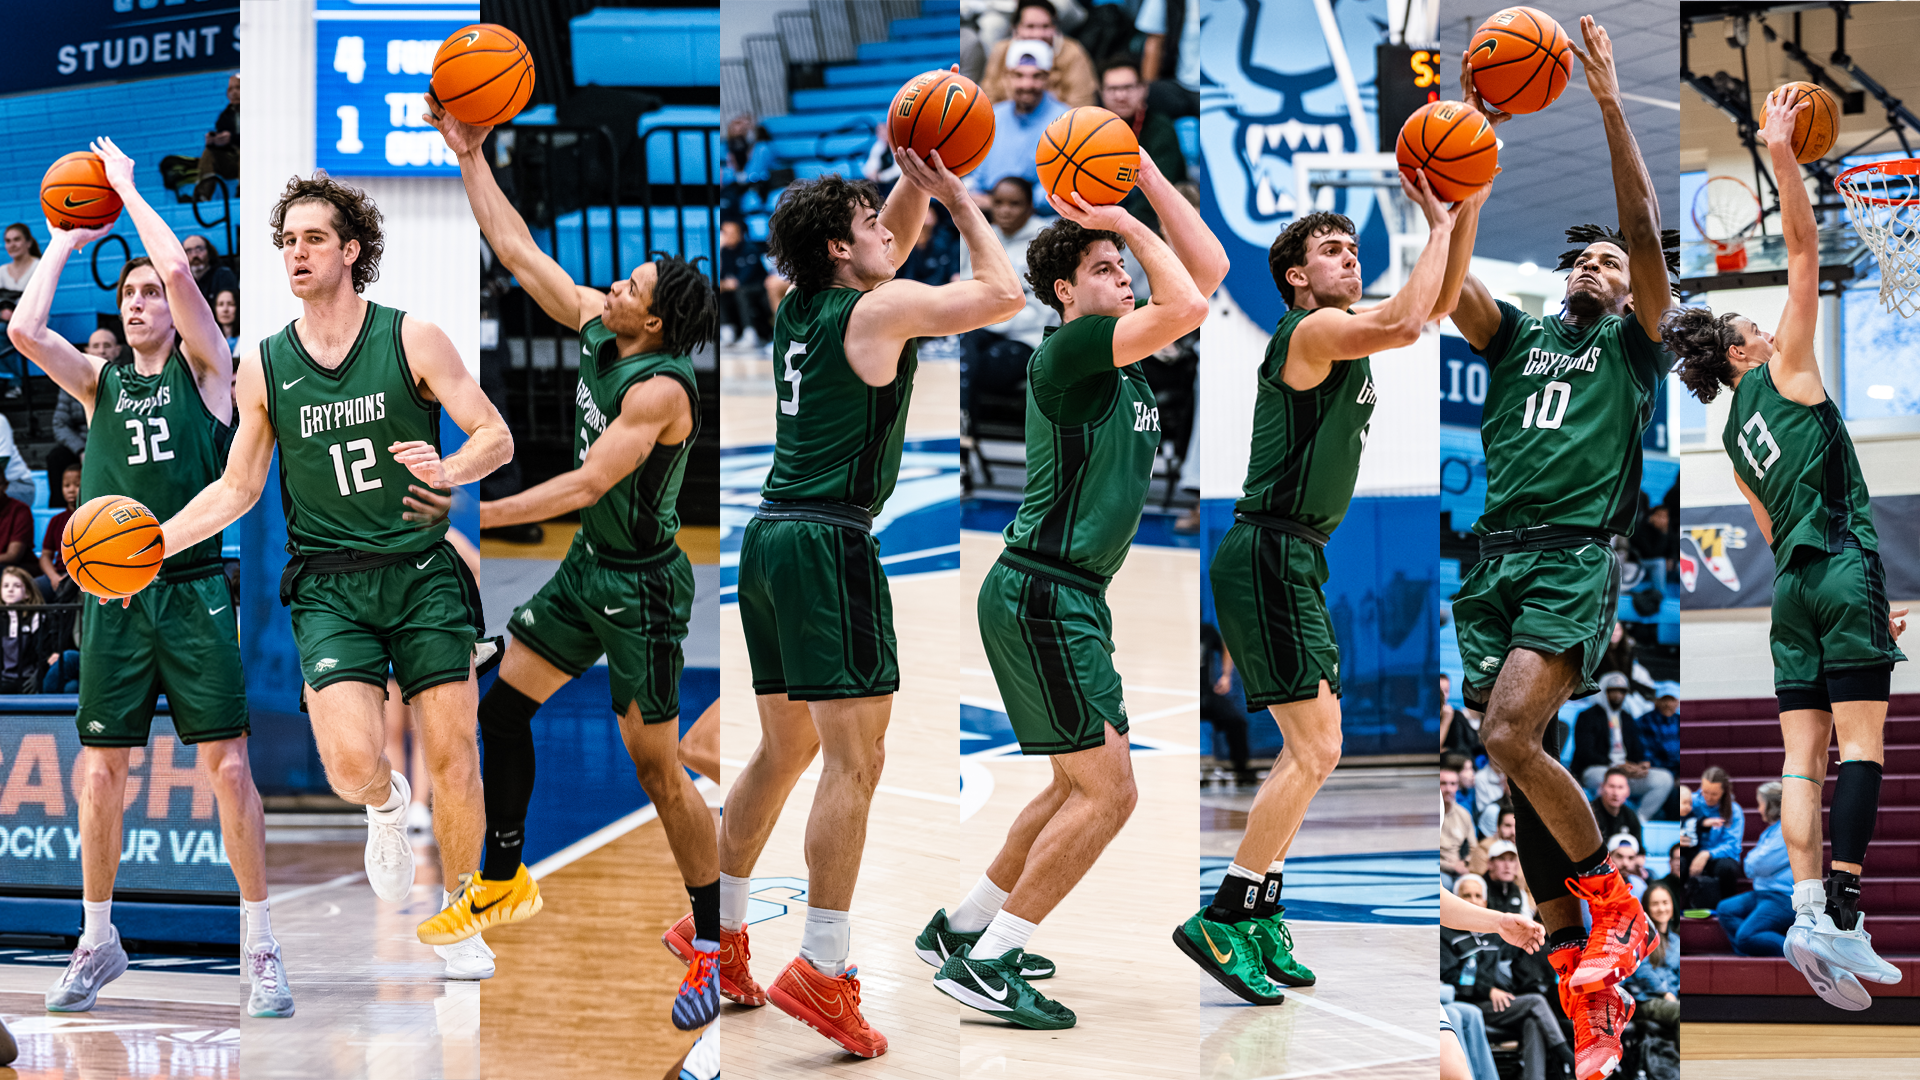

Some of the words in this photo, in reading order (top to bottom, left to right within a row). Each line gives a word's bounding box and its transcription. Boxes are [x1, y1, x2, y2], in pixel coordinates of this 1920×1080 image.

[57, 25, 221, 75] STUDENT
[780, 340, 807, 416] 5
[300, 391, 386, 439] GRYPHONS
[1521, 380, 1572, 430] 10
[125, 416, 175, 466] 32
[1737, 410, 1781, 480] 13
[328, 437, 383, 497] 12
[63, 827, 161, 864] YUR
